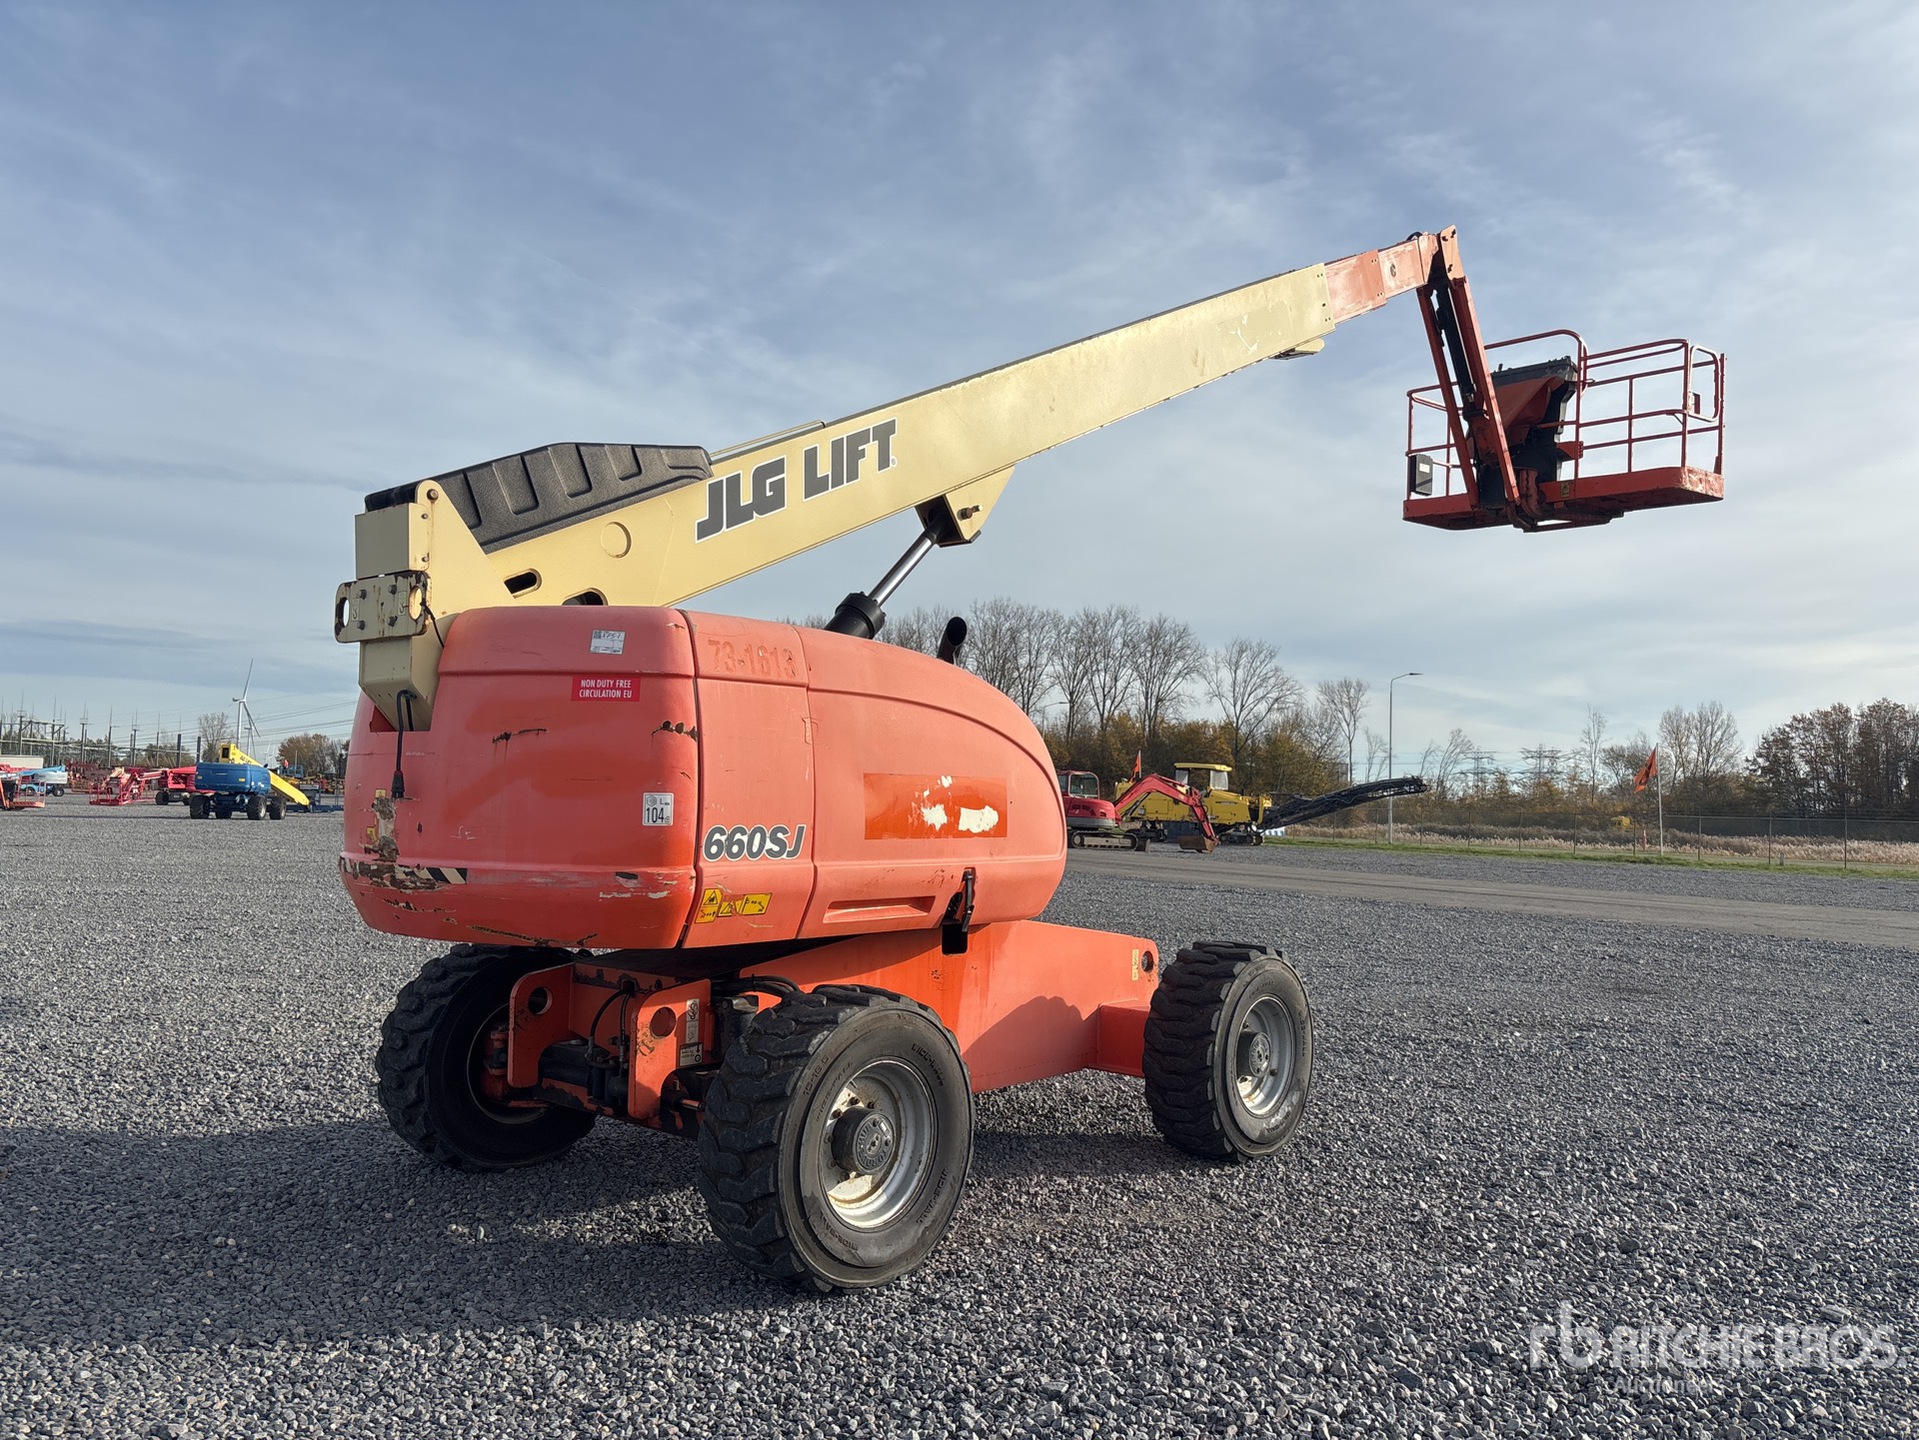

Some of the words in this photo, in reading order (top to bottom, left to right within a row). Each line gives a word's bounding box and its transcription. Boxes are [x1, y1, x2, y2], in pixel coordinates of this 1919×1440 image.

[695, 455, 786, 543] JLG
[803, 417, 897, 501] LIFT
[580, 679, 596, 688] NON
[596, 679, 614, 688] DUTY
[615, 679, 632, 688] FREE
[579, 689, 621, 698] CIRCULATION
[623, 690, 632, 698] EU
[646, 807, 664, 823] 104
[703, 824, 807, 862] 660SJ
